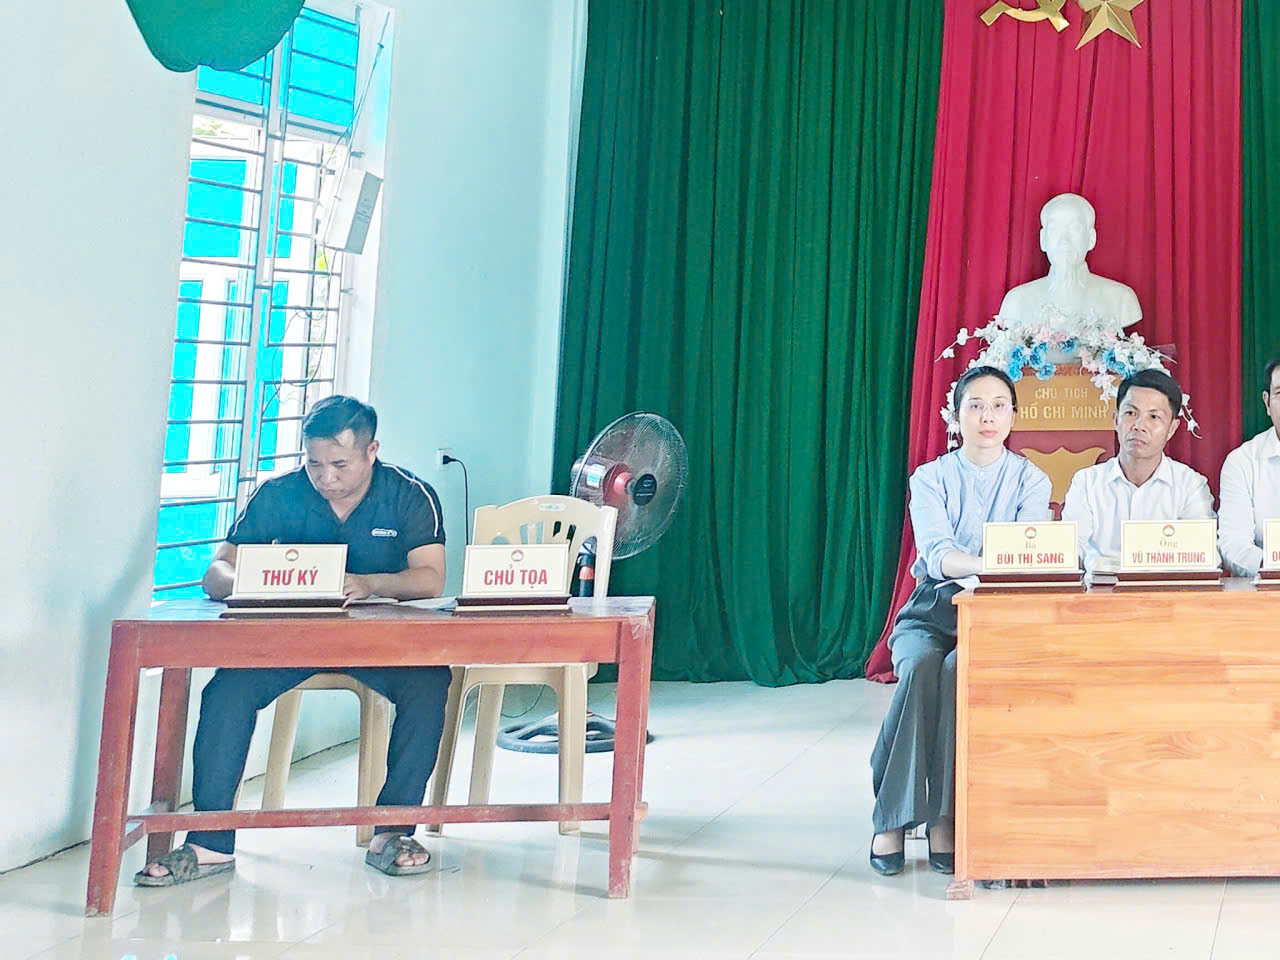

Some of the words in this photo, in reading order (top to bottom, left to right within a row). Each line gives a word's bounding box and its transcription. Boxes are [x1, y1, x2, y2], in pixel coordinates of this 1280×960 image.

[1071, 405, 1107, 419] MINH
[1036, 552, 1064, 564] SANG
[1177, 551, 1205, 563] TRUNG
[262, 568, 295, 585] THƯ
[484, 564, 515, 585] CHỦ
[520, 569, 547, 589] TỌA
